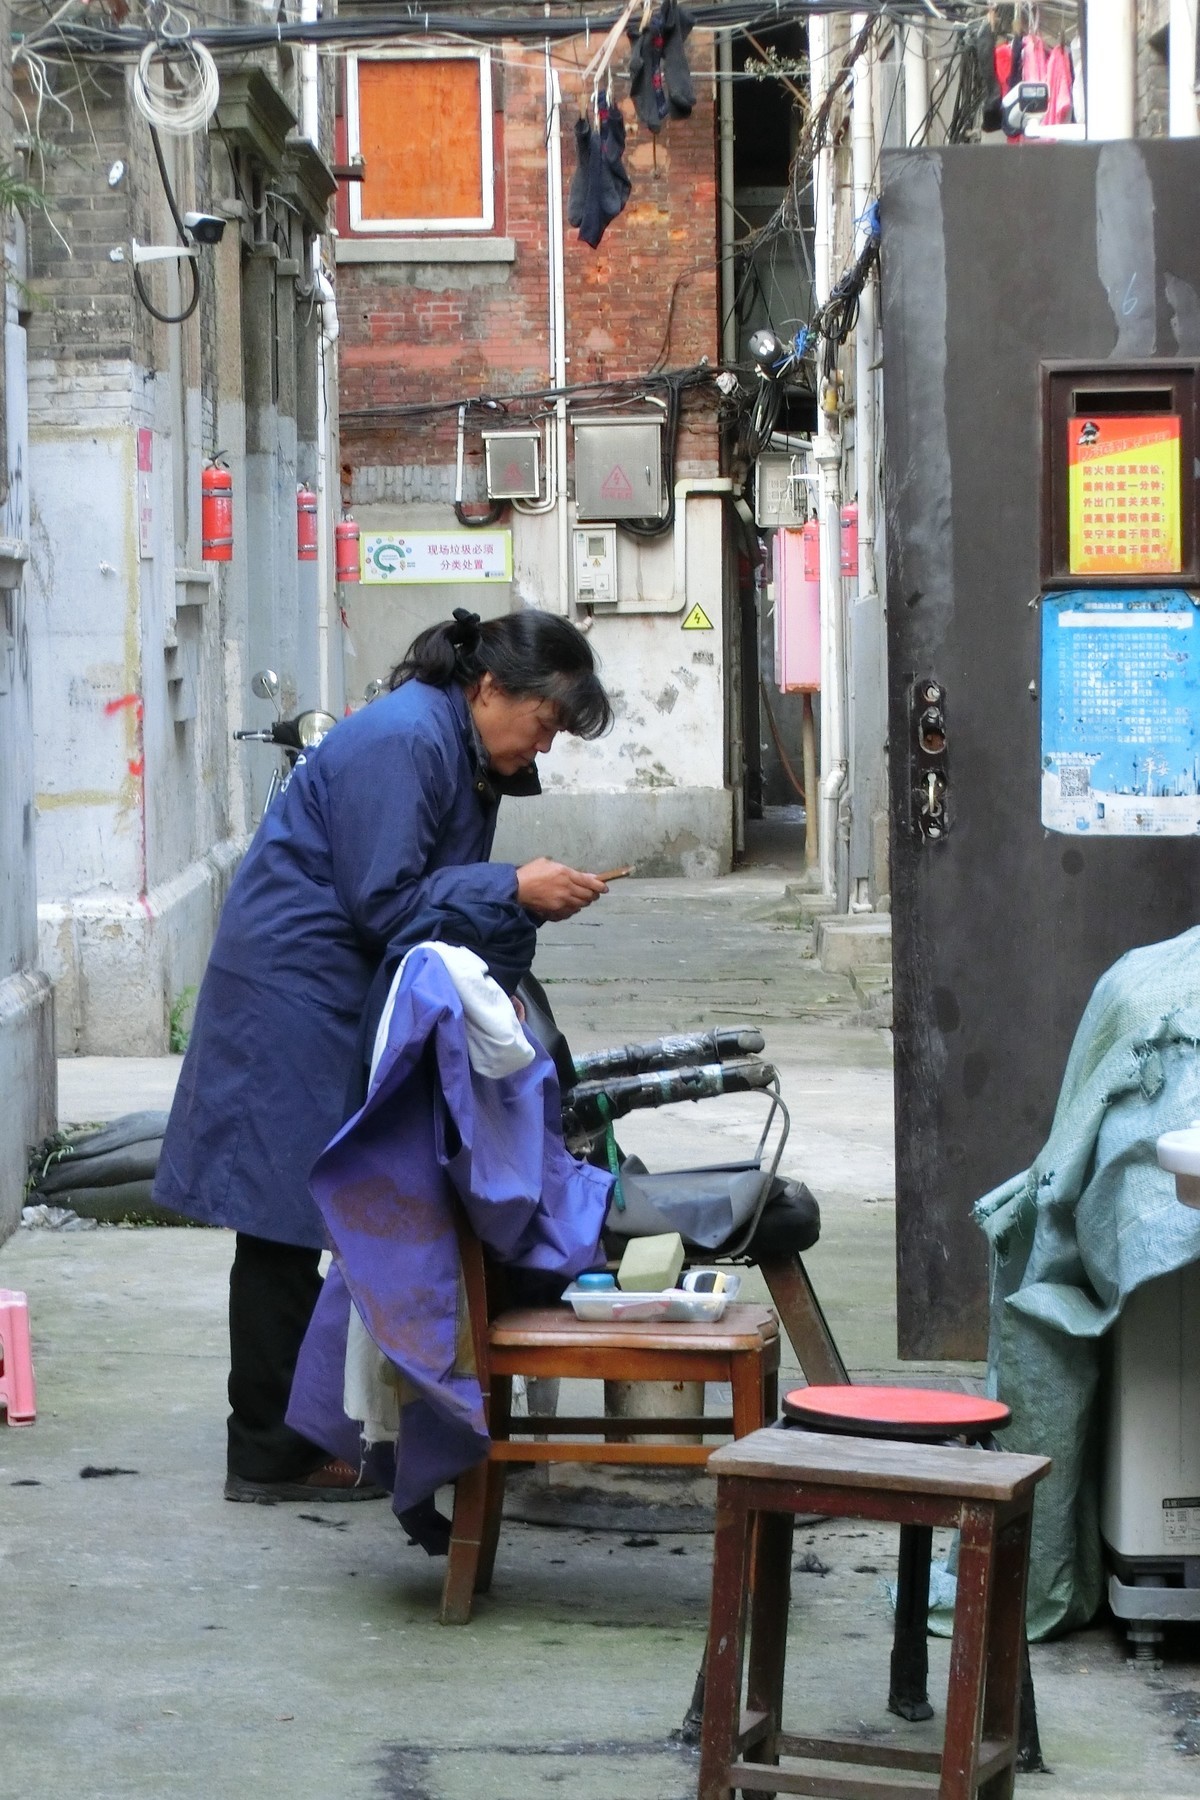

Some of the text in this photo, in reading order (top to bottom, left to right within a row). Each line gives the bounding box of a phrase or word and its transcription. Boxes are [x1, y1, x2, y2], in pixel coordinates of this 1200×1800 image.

[427, 543, 494, 556] 现场垃圾必须
[440, 559, 483, 571] 分类处置
